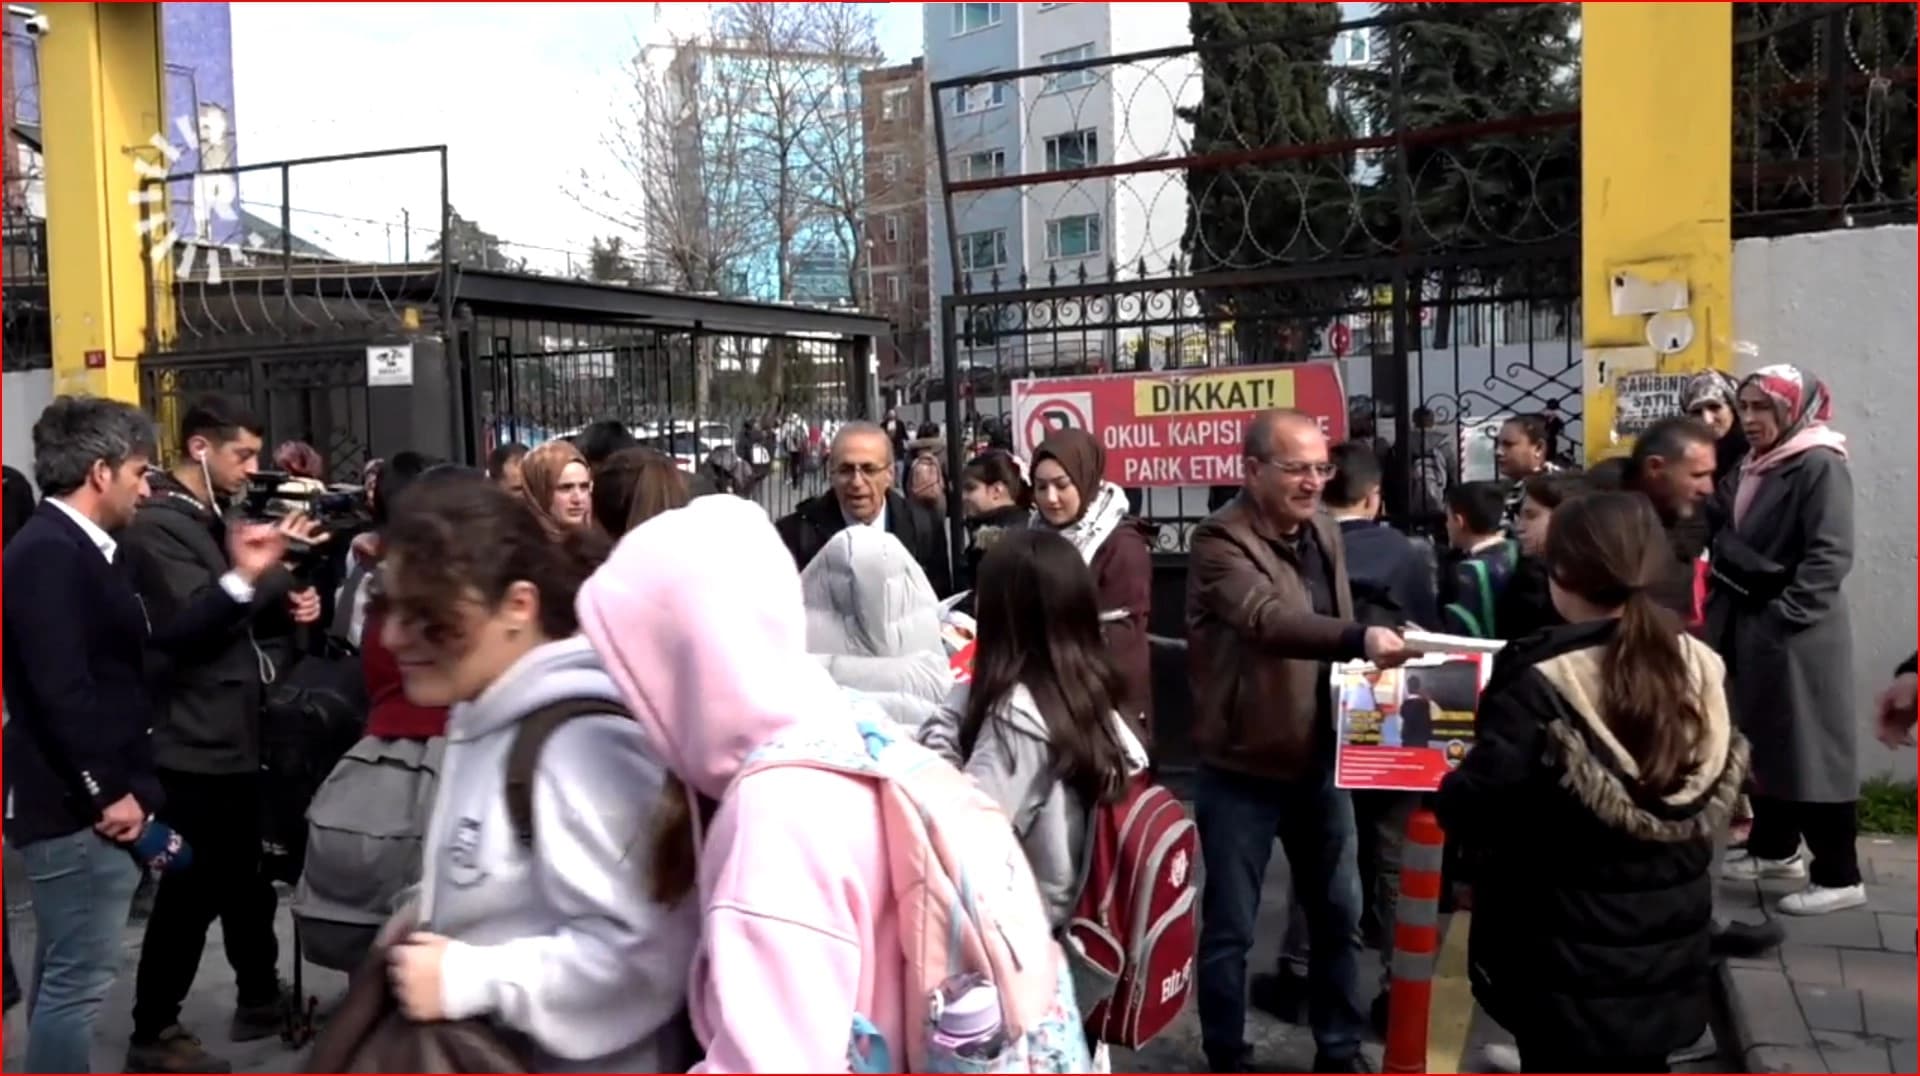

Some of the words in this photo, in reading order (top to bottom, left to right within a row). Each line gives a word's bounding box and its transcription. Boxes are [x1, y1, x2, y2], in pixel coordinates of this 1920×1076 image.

[1152, 378, 1275, 412] DİKKAT!
[1103, 423, 1161, 449] OKUL
[1168, 419, 1242, 446] KAPISI
[1124, 455, 1184, 482] PARK
[1190, 453, 1246, 480] ETME
[1161, 956, 1193, 1004] BİL
